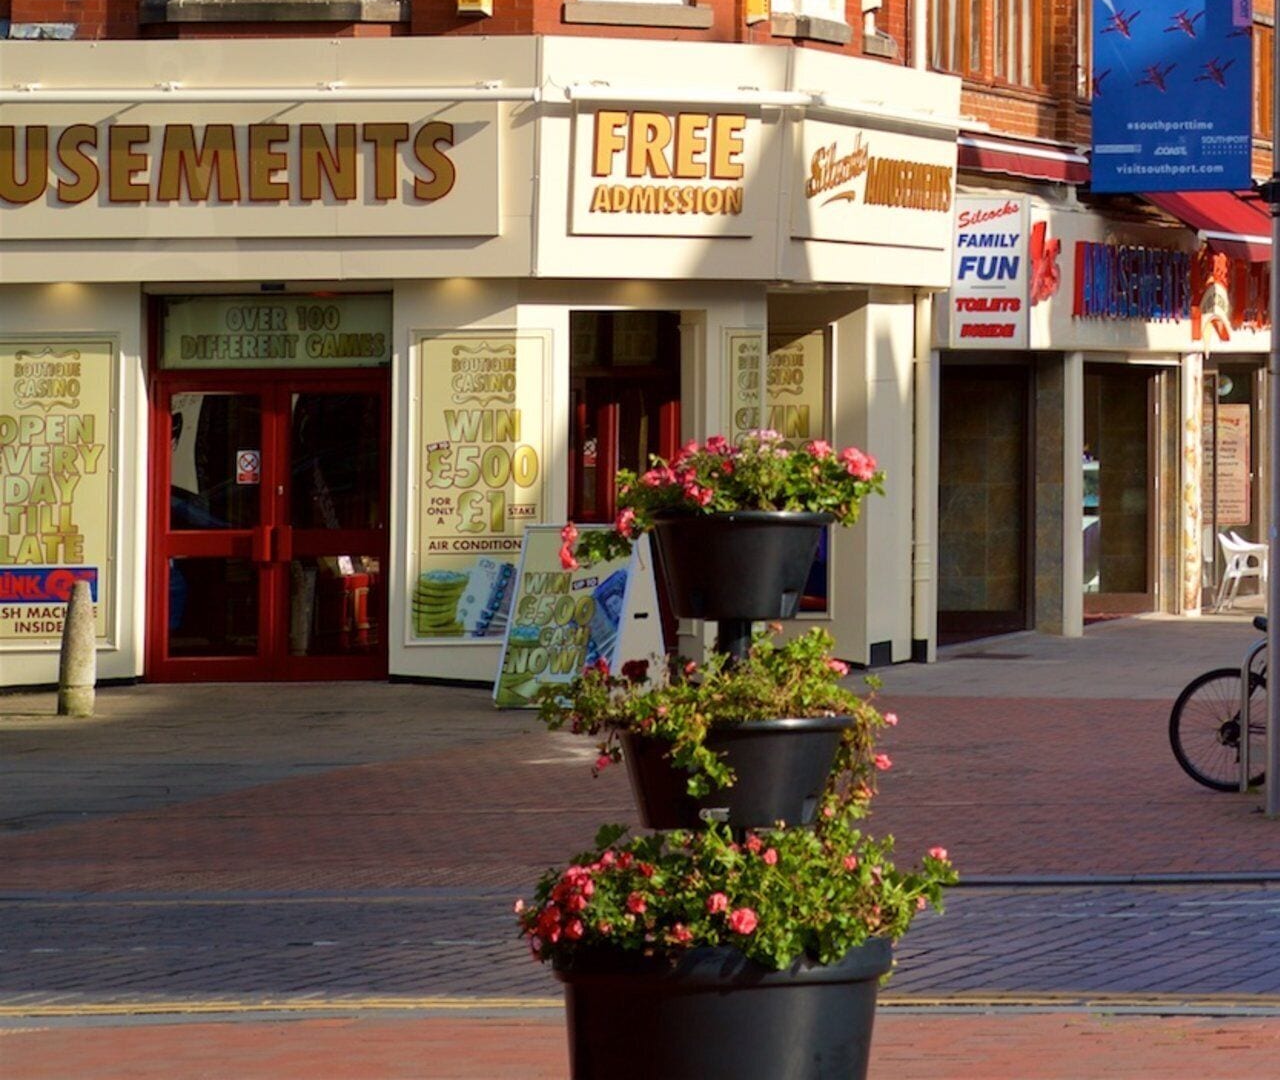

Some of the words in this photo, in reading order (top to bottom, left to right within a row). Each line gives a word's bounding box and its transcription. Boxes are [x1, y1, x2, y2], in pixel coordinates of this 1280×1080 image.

[592, 110, 746, 179] FREE
[1116, 164, 1224, 176] visitsouthport.com
[863, 156, 952, 213] AMUSEMENTS
[589, 184, 743, 215] ADMISSION
[958, 200, 1019, 229] Silcocks
[957, 234, 1020, 248] FAMILY
[957, 256, 1020, 281] FUN
[955, 298, 1021, 312] TOILETS
[225, 306, 288, 331] OVER
[296, 305, 340, 331] 100
[960, 323, 1016, 338] INSIDE
[181, 333, 300, 360] DIFFERENT
[306, 333, 386, 359] GAMES
[14, 361, 81, 378] BOUTIQUE
[14, 378, 81, 399] CASINO
[452, 373, 516, 393] CASINO
[0, 414, 95, 445] OPEN
[444, 410, 521, 443] WIN
[425, 444, 539, 489] £500
[4, 474, 82, 505] DAY
[430, 497, 451, 506] FOR
[3, 505, 79, 535] TILL
[427, 506, 454, 516] ONLY
[507, 506, 536, 516] STAKE
[437, 517, 444, 525] A
[455, 490, 505, 534] £1
[0, 535, 85, 565] LATE
[428, 540, 449, 551] AIR
[524, 571, 573, 595] WIN
[515, 595, 596, 627] £500
[14, 621, 63, 634] INSIDE
[538, 627, 591, 647] CASH
